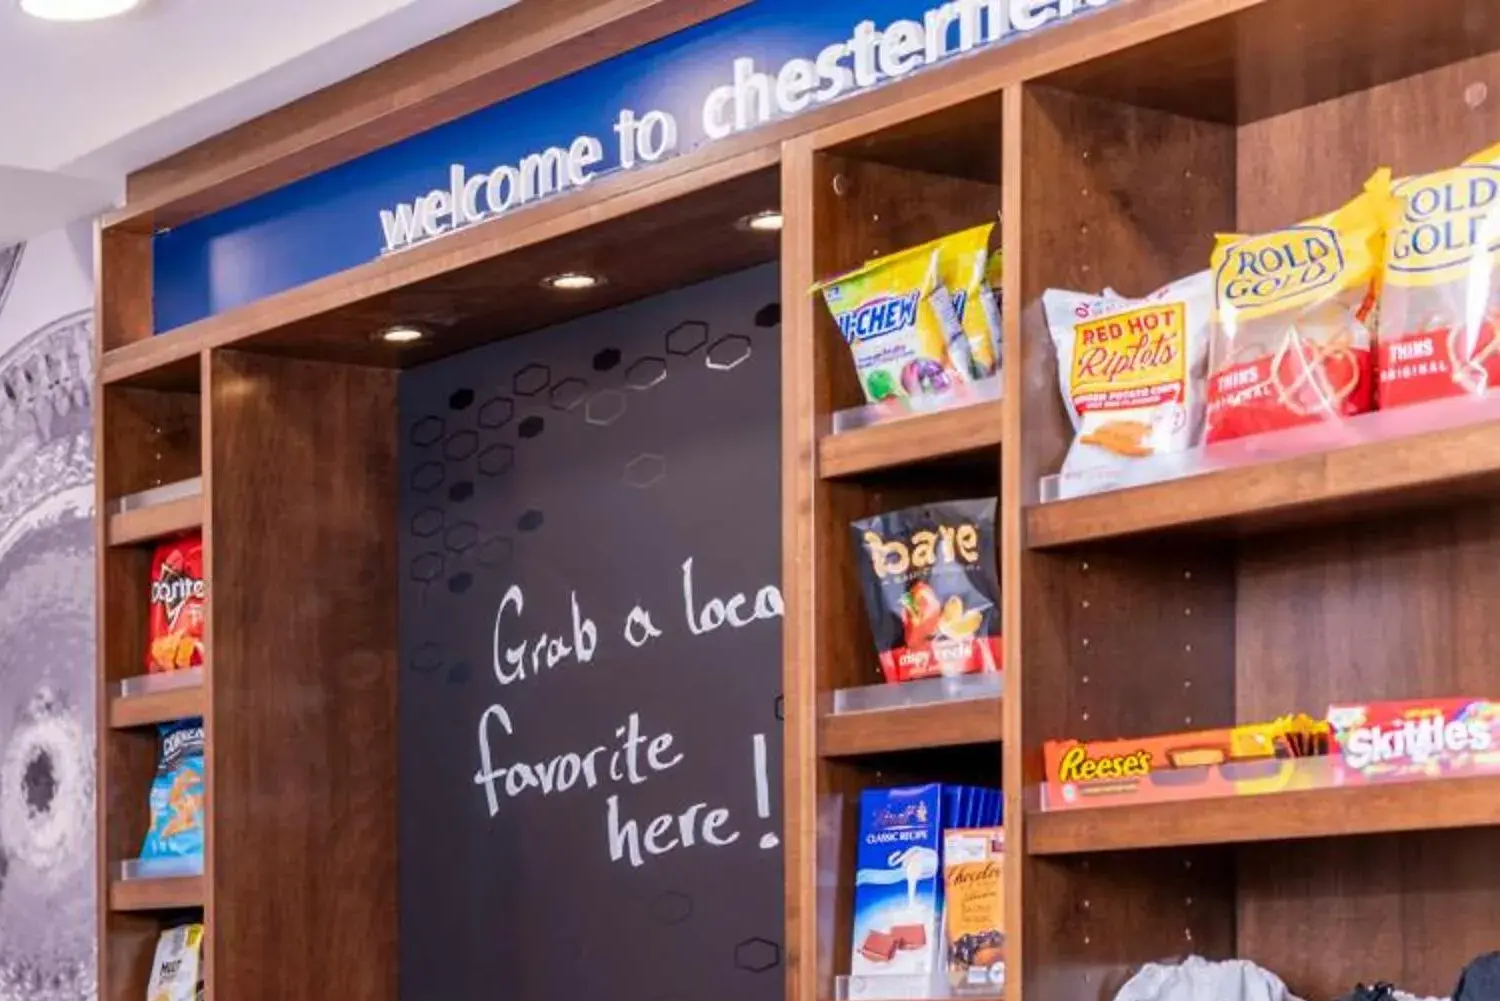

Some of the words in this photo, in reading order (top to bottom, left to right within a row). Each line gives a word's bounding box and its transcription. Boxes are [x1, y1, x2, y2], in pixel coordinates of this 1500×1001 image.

[380, 136, 603, 250] welcome
[614, 109, 677, 169] to
[1238, 237, 1330, 277] ROLD
[1082, 323, 1123, 345] RED
[1128, 309, 1176, 335] HOT
[1077, 331, 1178, 383] Riplets
[864, 524, 979, 578] bare
[493, 584, 598, 686] Grab
[623, 604, 663, 647] a
[474, 703, 685, 818] favorite
[1343, 714, 1492, 770] Skittles
